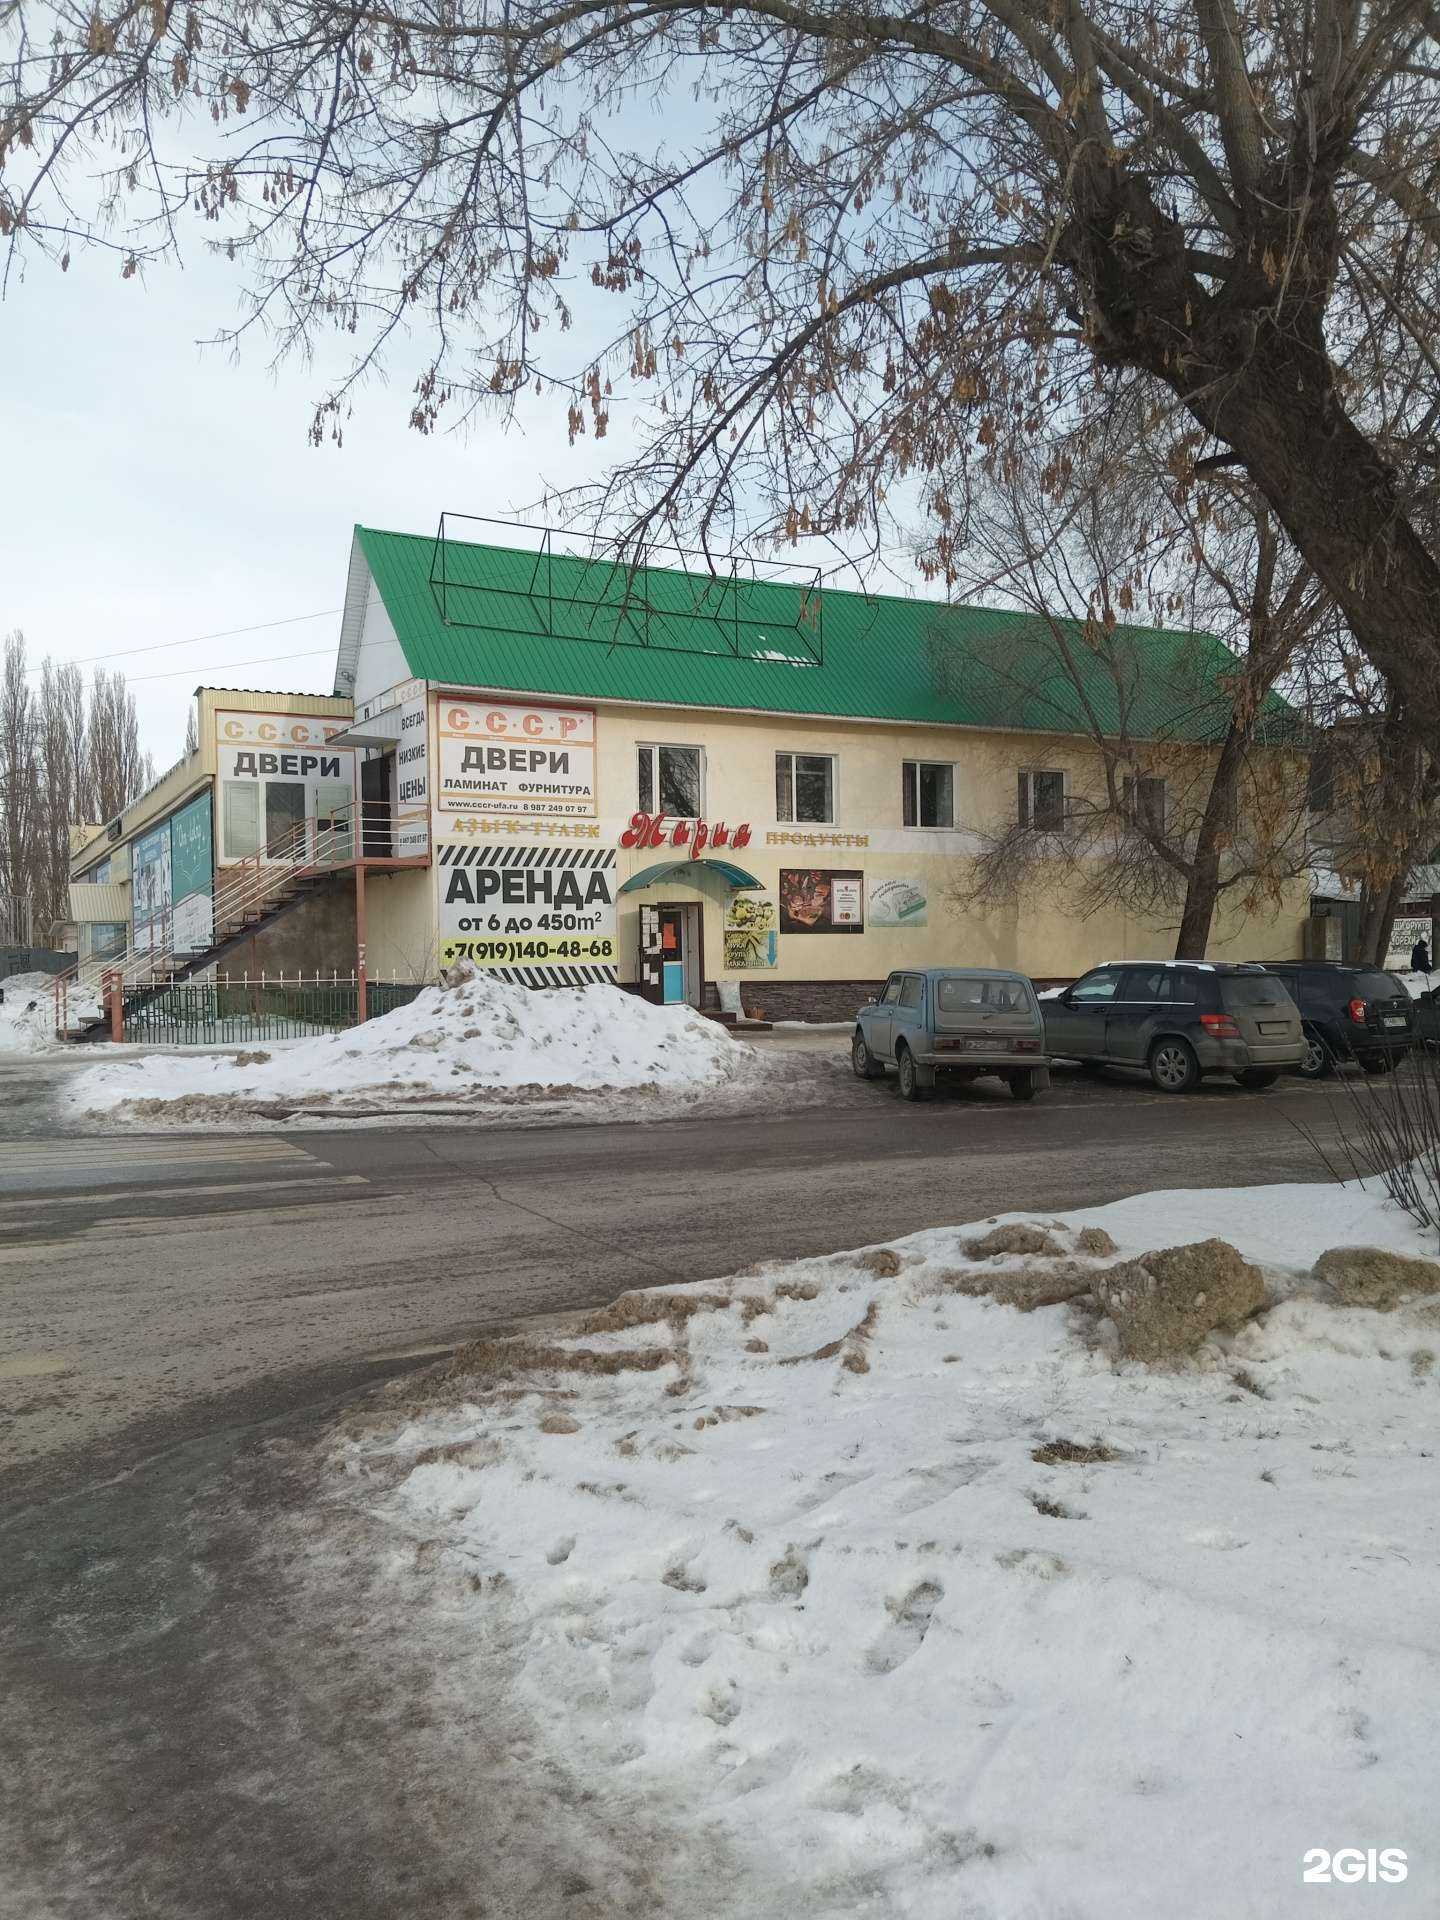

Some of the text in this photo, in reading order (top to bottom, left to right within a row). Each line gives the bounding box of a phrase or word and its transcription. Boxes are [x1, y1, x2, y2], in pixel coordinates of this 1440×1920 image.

[401, 710, 425, 731] ВСЕГДА
[234, 752, 340, 777] ДВЕРИ
[399, 744, 426, 765] НИЗКИЕ
[461, 745, 570, 774] ДВЕРИ
[400, 777, 426, 803] ЦЕНЫ
[444, 778, 591, 796] ЛАМИНАТ ФУРНИТУРА
[523, 803, 529, 811] 8
[531, 803, 546, 811] 987
[549, 804, 563, 812] 249
[565, 805, 575, 813] 07
[577, 805, 587, 813] 97
[766, 831, 870, 848] ПРОДУКТЫ
[445, 868, 612, 911] АРЕНДА
[458, 917, 483, 931] от
[487, 914, 500, 931] 6
[504, 917, 533, 934] до
[444, 940, 613, 962] +7(919)140-48-68
